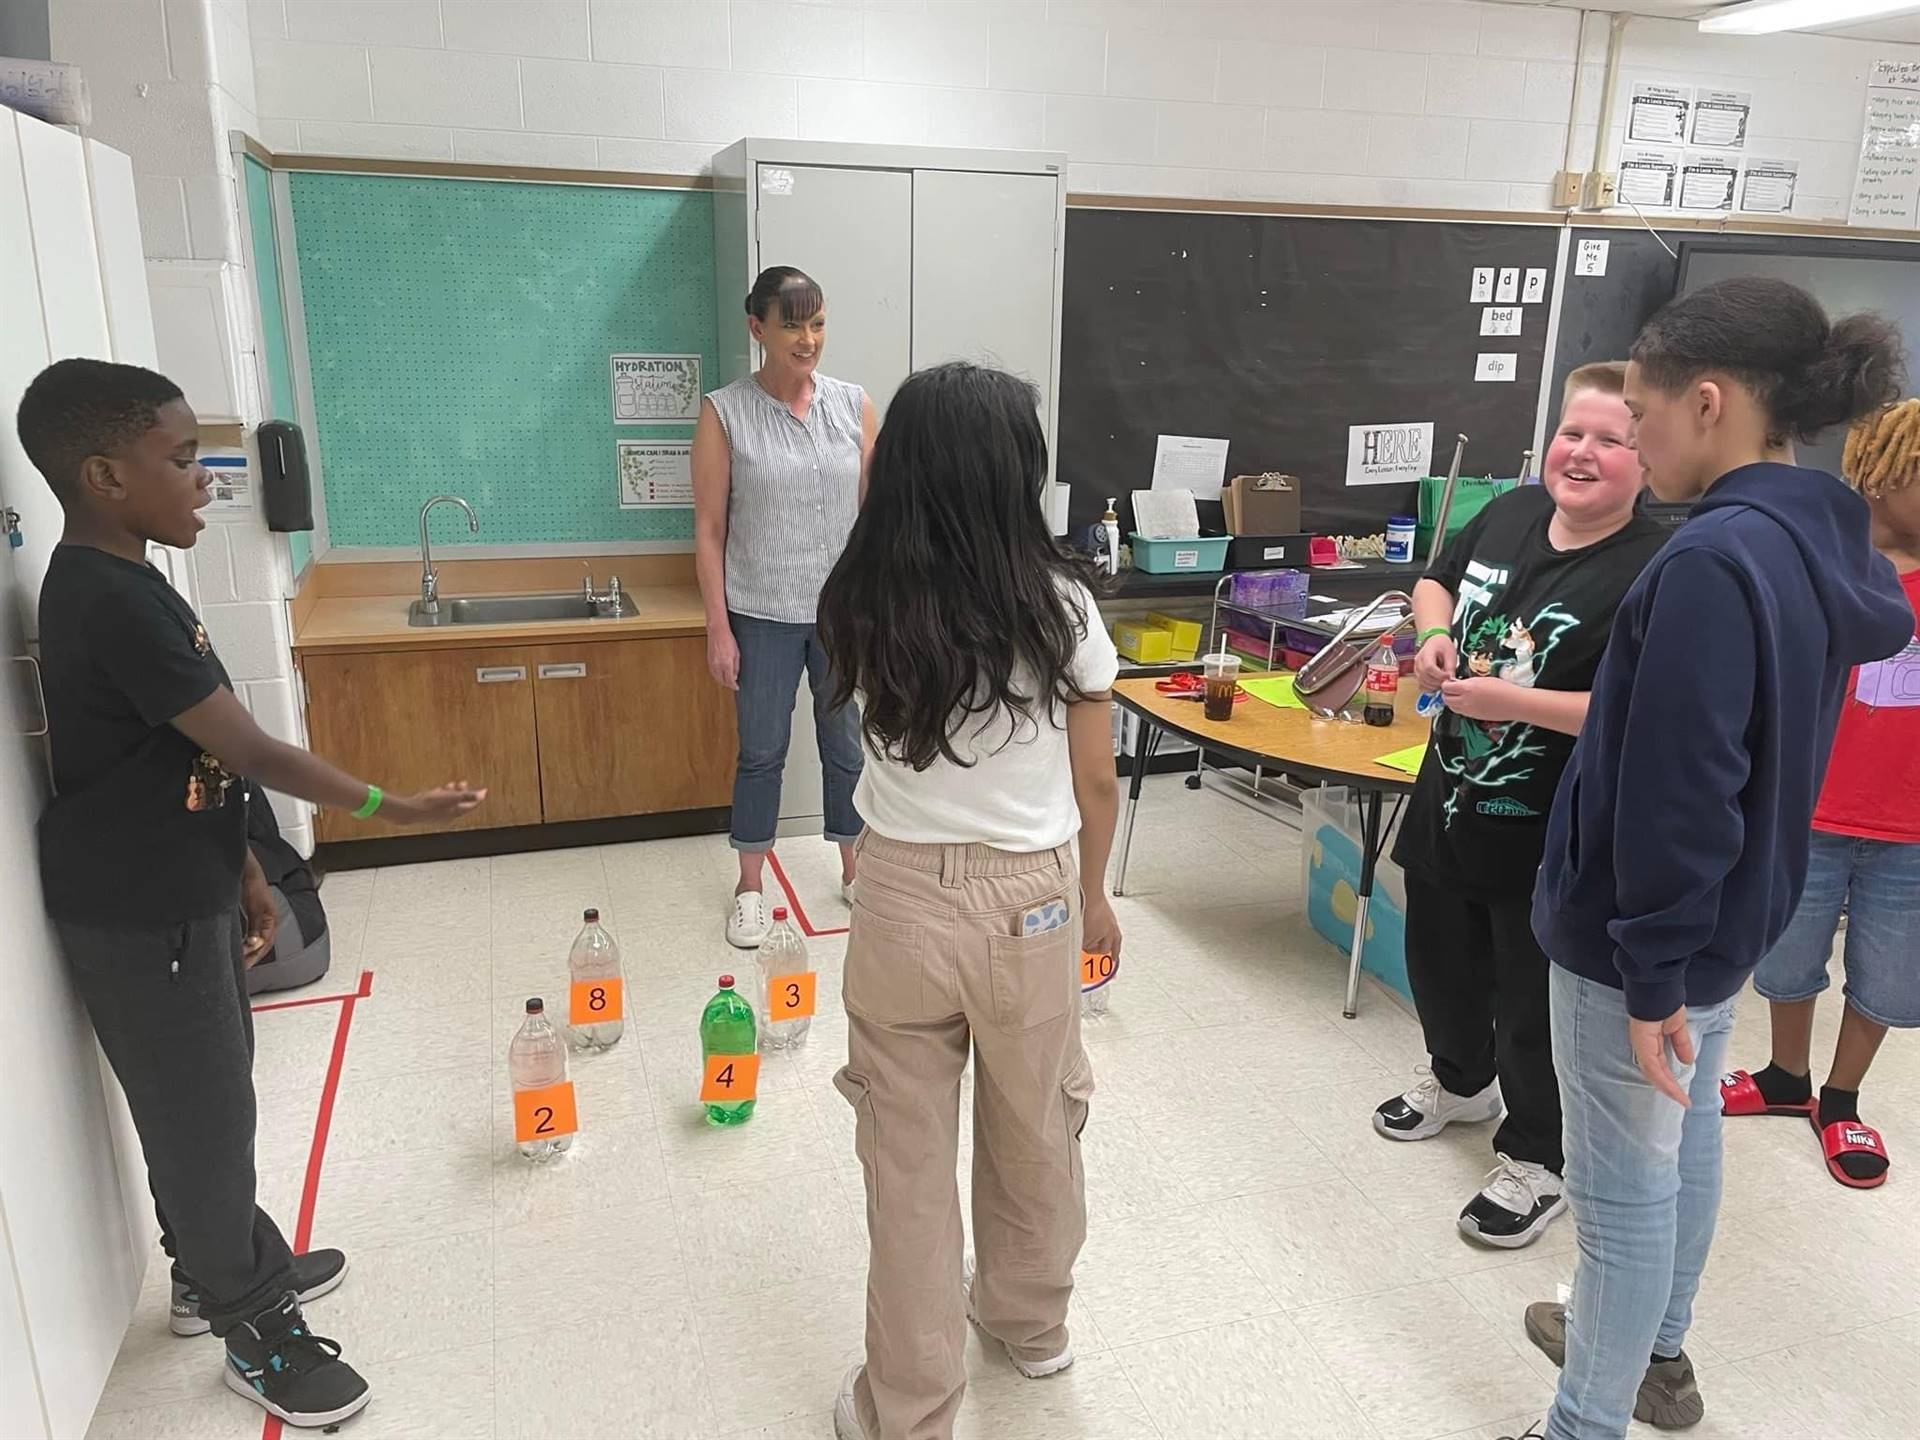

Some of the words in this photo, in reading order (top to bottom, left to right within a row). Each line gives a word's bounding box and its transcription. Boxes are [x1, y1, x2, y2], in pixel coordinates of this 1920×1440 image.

[1584, 241, 1601, 251] Give
[1586, 253, 1598, 261] Me
[1586, 262, 1595, 272] 5
[1479, 272, 1487, 285] b
[1503, 272, 1512, 285] d
[1530, 277, 1538, 289] p
[1491, 309, 1513, 321] bed
[615, 361, 683, 373] HYDRATION
[1488, 361, 1505, 374] dip
[1361, 429, 1422, 466] HERE
[1085, 955, 1113, 979] 10
[589, 987, 606, 1011] 8
[785, 983, 800, 1008] 3
[715, 1063, 734, 1089] 4
[534, 1106, 555, 1134] 2
[1846, 1133, 1876, 1147] NIKE
